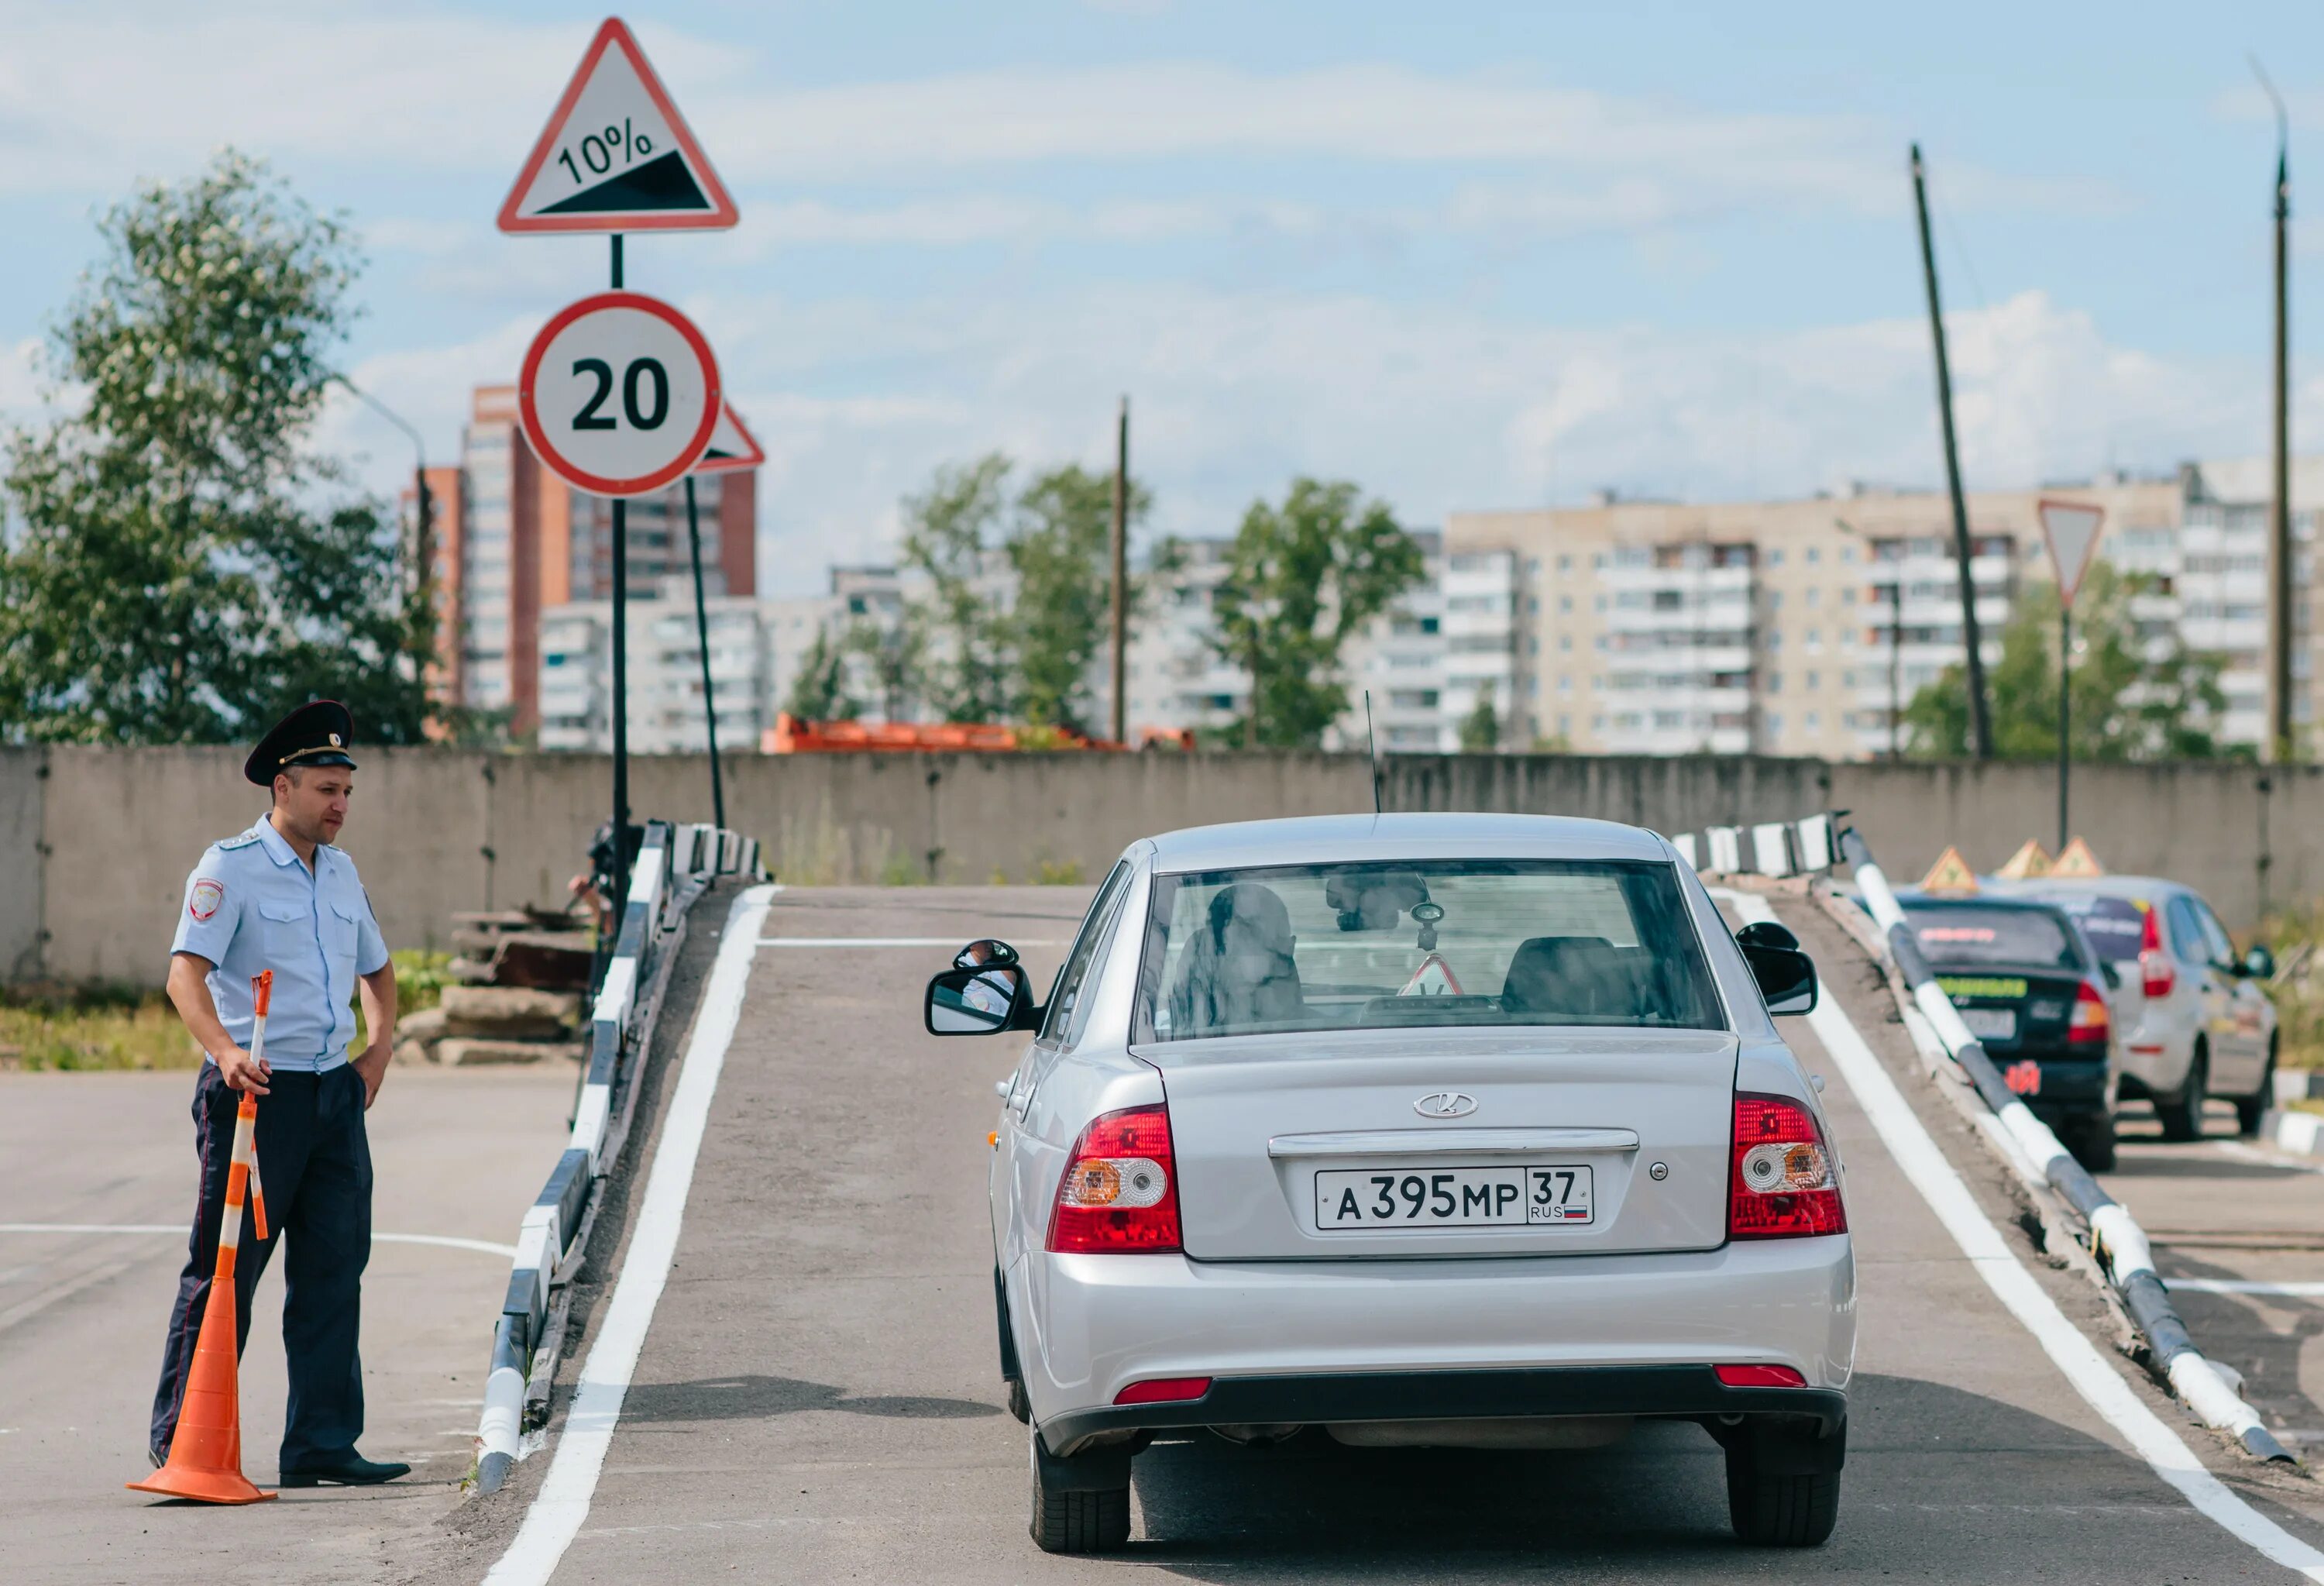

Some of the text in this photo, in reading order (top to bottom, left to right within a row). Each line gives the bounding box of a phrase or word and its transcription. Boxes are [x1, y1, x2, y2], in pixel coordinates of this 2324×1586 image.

[559, 117, 652, 184] 10%
[572, 356, 669, 431] 20
[1531, 1206, 1563, 1219] RUS
[1532, 1171, 1576, 1205] 37
